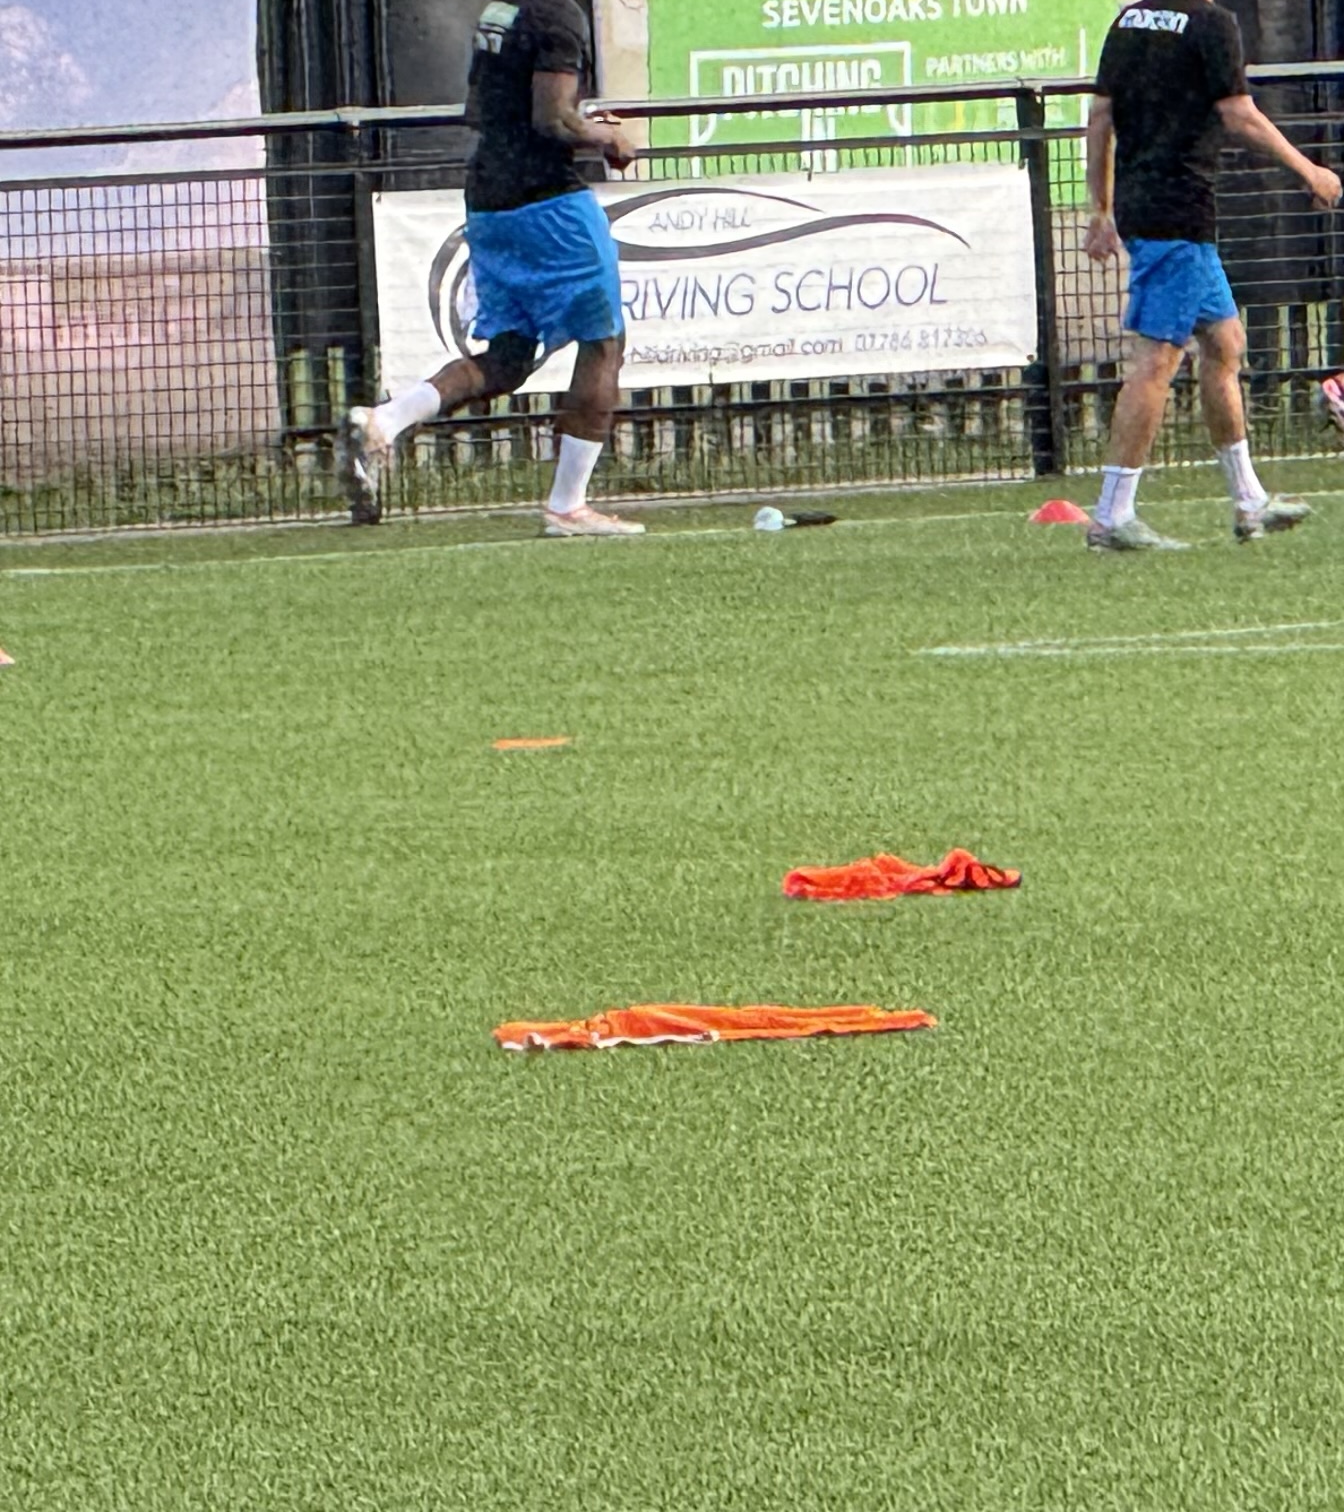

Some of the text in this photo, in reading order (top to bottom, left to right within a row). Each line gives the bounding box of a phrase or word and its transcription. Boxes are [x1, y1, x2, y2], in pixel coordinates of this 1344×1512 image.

[926, 45, 1066, 77] PARTNERS WITH
[722, 59, 882, 120] PITCHING
[648, 205, 752, 233] ANDY HILL
[621, 263, 948, 321] RIVING SCHOOL
